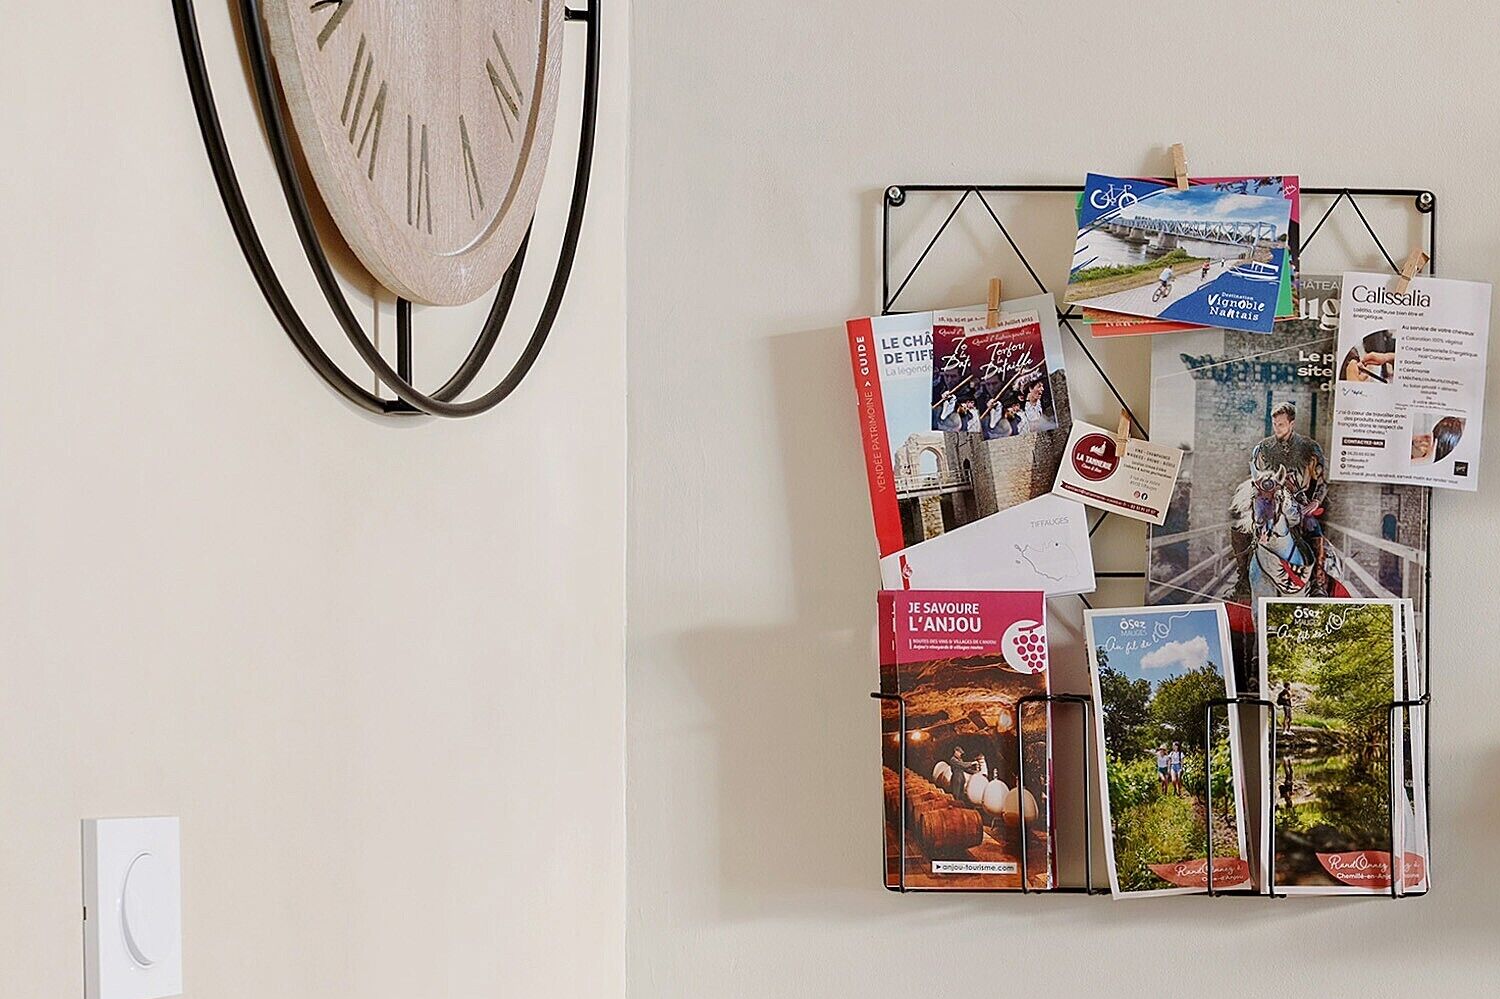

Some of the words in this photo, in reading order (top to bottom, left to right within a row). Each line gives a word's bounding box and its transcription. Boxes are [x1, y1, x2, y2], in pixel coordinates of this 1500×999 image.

[1352, 284, 1431, 308] Calissalia
[881, 337, 900, 349] LE
[856, 335, 869, 376] GUIDE
[883, 353, 903, 365] DE
[1299, 350, 1320, 362] Le
[1297, 364, 1333, 377] site
[864, 390, 880, 452] PATRIMOINE
[871, 452, 886, 493] VENDÉE
[1030, 516, 1069, 528] TIFFAUGES
[908, 602, 921, 614] JE
[923, 602, 980, 615] SAVOURE
[909, 616, 982, 633] L'ANJOU
[942, 863, 1015, 872] anjou-tourisme.com
